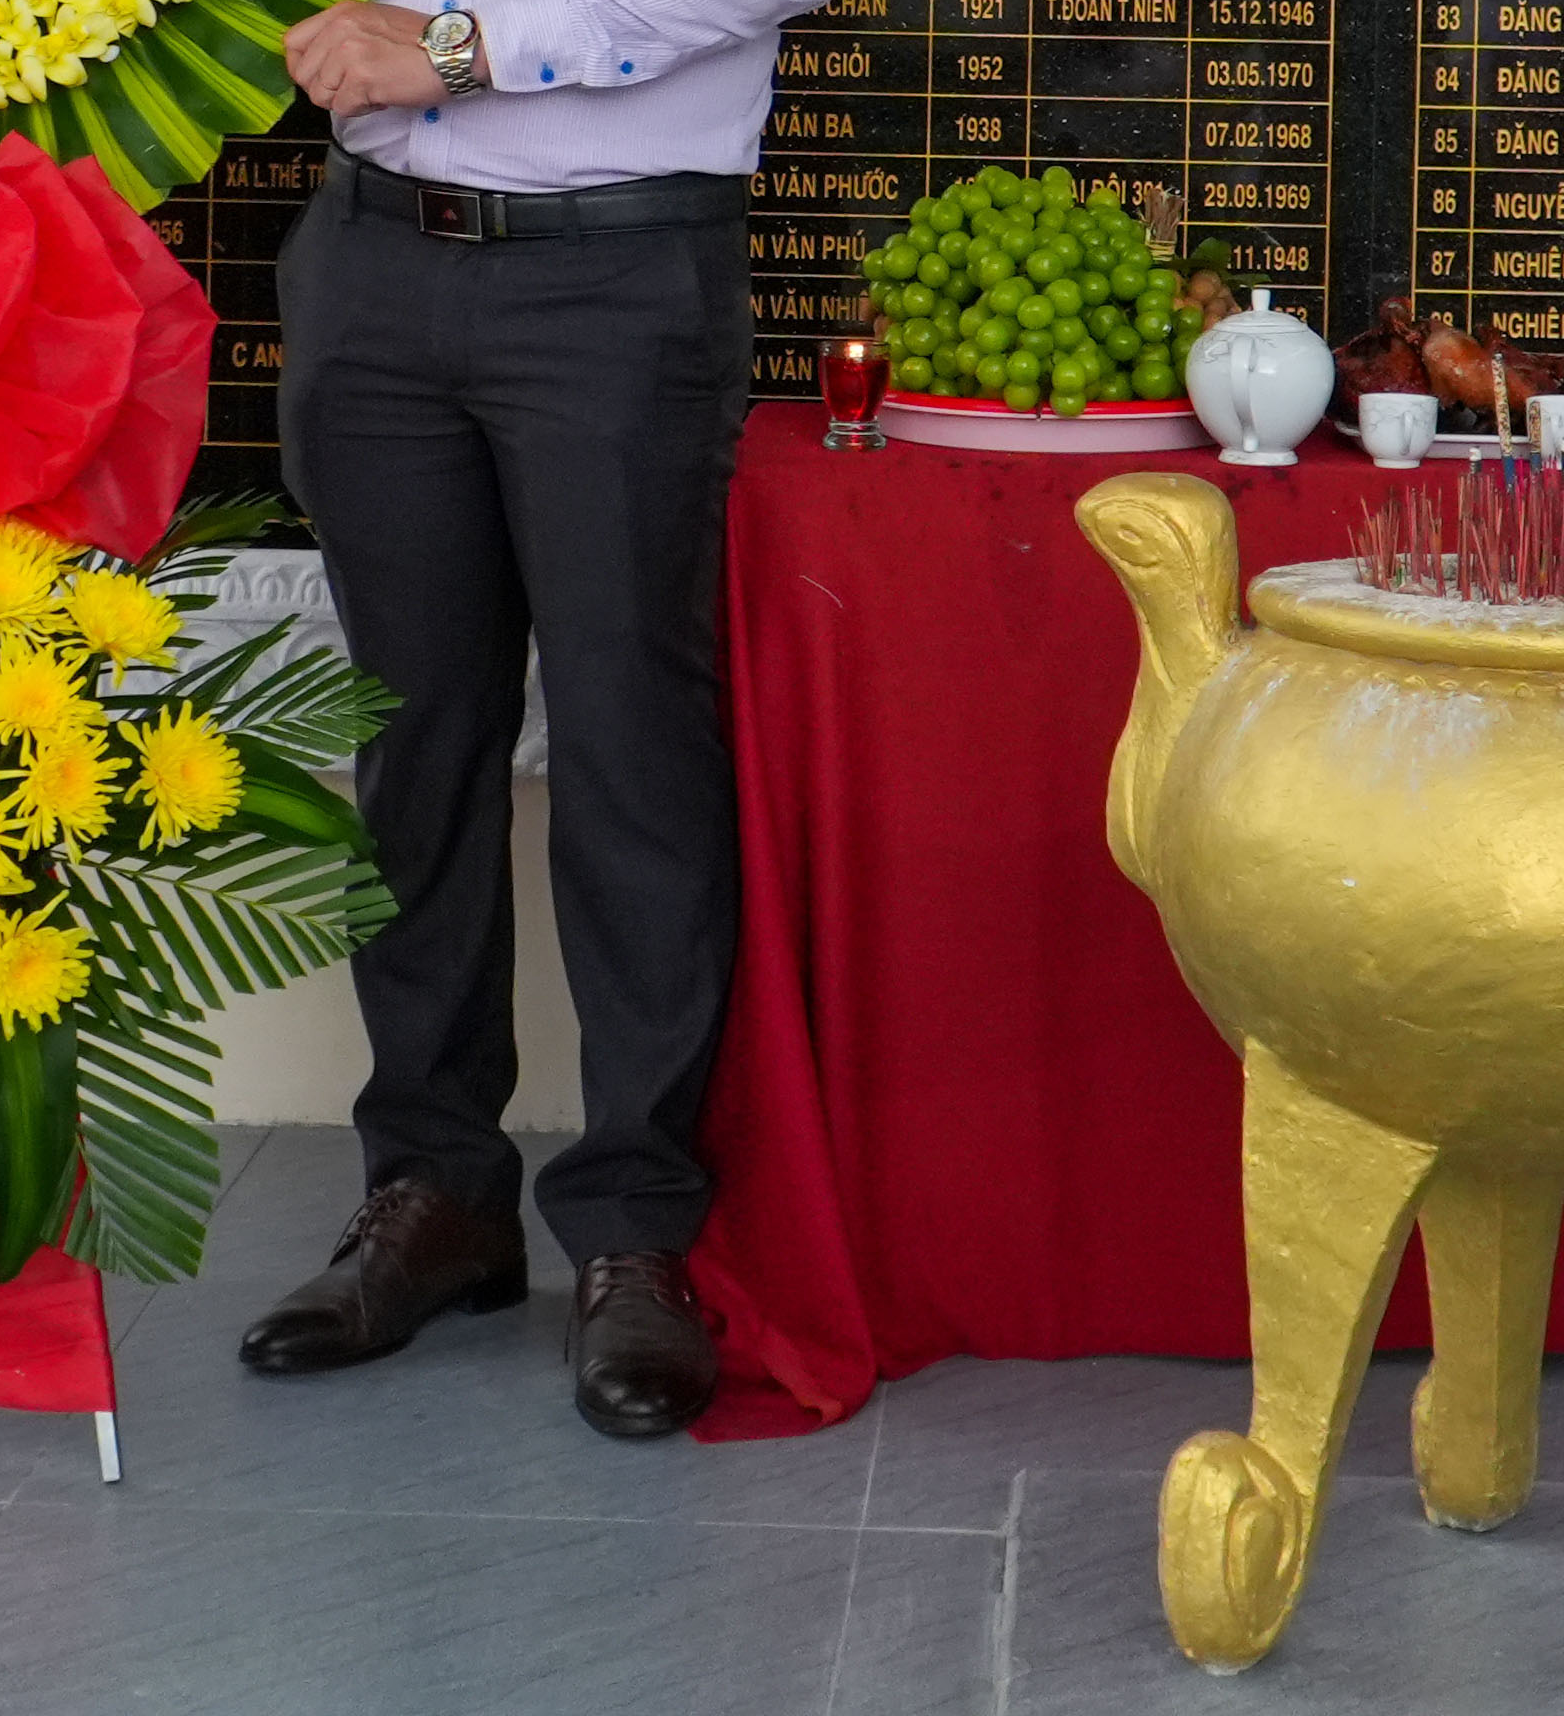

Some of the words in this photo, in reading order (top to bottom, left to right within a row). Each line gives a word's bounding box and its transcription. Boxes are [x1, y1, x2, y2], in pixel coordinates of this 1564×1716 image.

[957, 55, 1004, 81] 1952
[1205, 60, 1314, 88] 03.05.1970
[1435, 66, 1460, 92] 84
[1496, 60, 1561, 98] ĐẶNG
